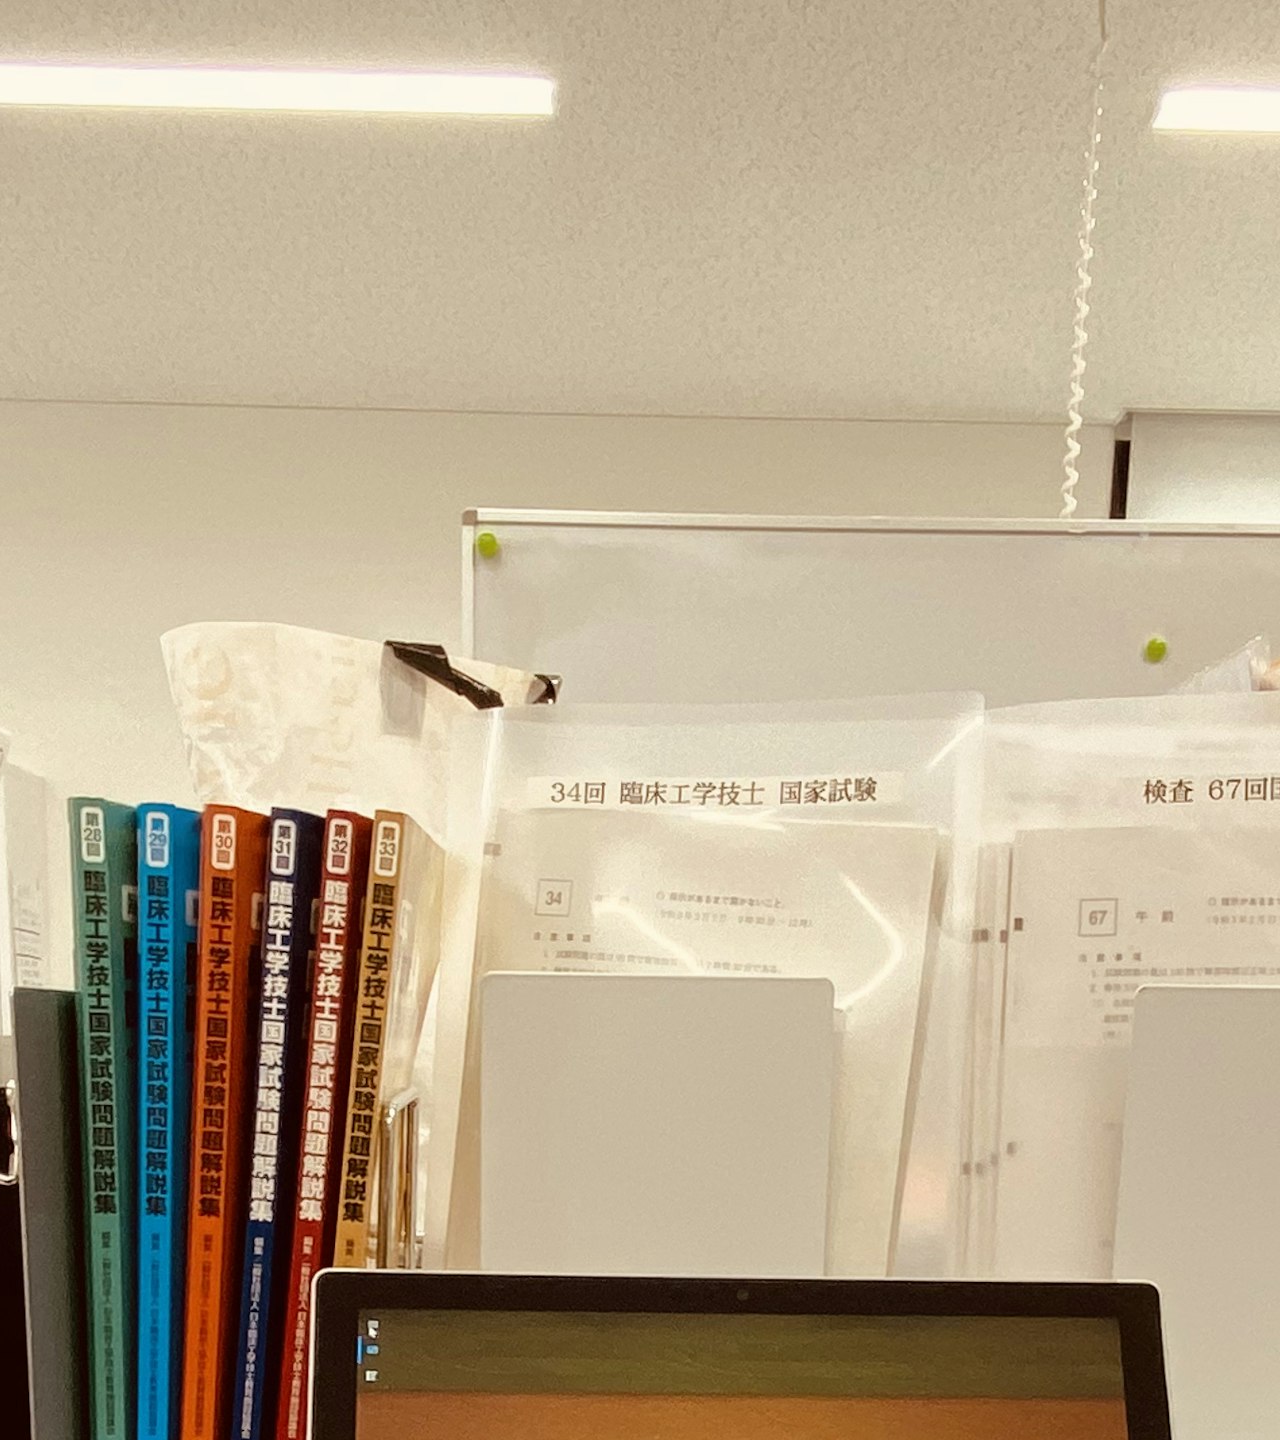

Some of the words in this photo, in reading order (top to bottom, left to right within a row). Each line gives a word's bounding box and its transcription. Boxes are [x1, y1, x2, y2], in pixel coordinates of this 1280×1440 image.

[545, 891, 562, 905] 34
[551, 782, 606, 804] 34回
[620, 781, 765, 806] 臨床工学技士
[780, 777, 877, 804] 国家試験
[1089, 910, 1108, 925] 67
[1142, 778, 1194, 804] 検査
[83, 870, 117, 1216] 臨床工学技士国家試験問題解説集
[146, 875, 170, 1216] 臨床工学技士国家試験問題解説集
[199, 877, 234, 1217] 臨床工学技士国家試験問題解説集
[248, 880, 295, 1222] 臨床工学技士国家試験問題解説集
[298, 880, 349, 1222] 臨床工学技士国家試験問題解説集
[343, 883, 395, 1222] 臨床工学技士国家試験問題解説集
